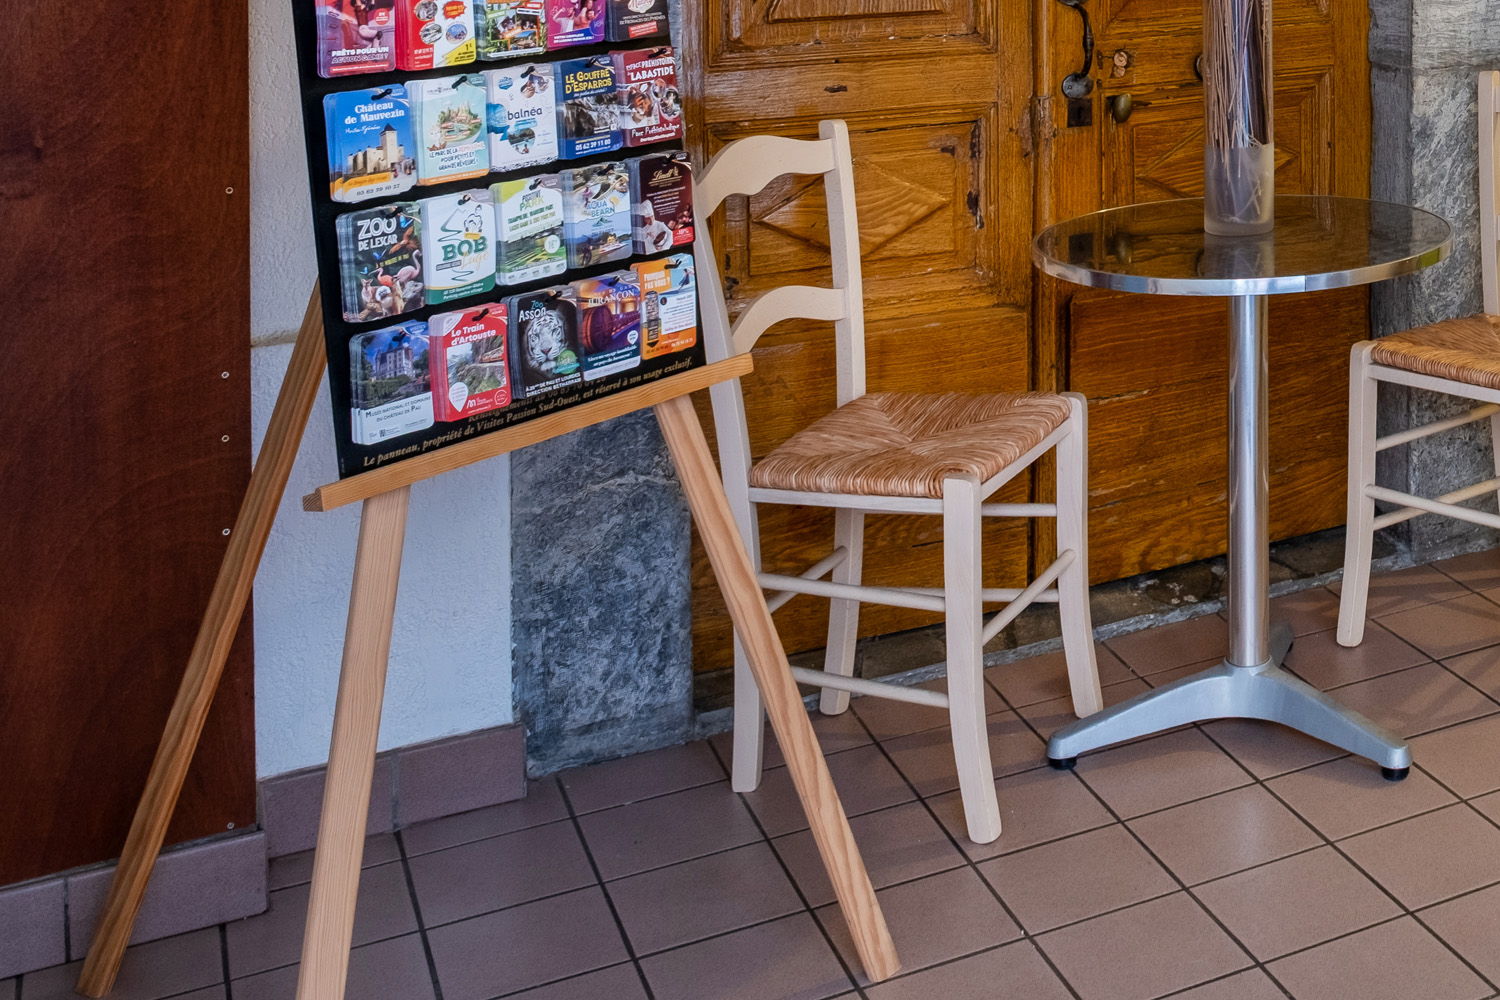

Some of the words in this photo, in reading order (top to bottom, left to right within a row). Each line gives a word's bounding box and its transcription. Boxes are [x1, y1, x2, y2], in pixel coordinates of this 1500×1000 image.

[565, 74, 575, 84] LE
[576, 68, 610, 82] GOUFFRE
[630, 66, 674, 81] LABASTIDE
[565, 78, 612, 94] D'ESPARROS
[354, 102, 394, 114] Château
[508, 106, 542, 120] balnéa
[344, 116, 358, 125] de
[360, 108, 405, 123] Mauvezin
[632, 129, 644, 138] Parc
[654, 168, 674, 180] Lindt
[520, 196, 544, 210] PARK
[358, 216, 397, 240] ZOO
[358, 240, 370, 252] DE
[370, 234, 398, 248] LESCAR
[442, 236, 488, 261] BOB
[531, 300, 544, 310] Zoo
[588, 290, 636, 308] JURANÇON
[451, 329, 496, 346] d'Artouste
[452, 330, 462, 338] Le
[463, 323, 484, 334] Train
[363, 456, 374, 467] Le
[376, 444, 421, 466] panneau,
[422, 432, 462, 451] propriété
[464, 424, 475, 436] de
[476, 418, 505, 432] Visites
[506, 408, 537, 422] Passion
[538, 394, 581, 412] Sud-Ouest,
[582, 390, 594, 399] est
[594, 382, 622, 395] réservé
[629, 376, 642, 384] son
[643, 368, 662, 381] usage
[664, 356, 692, 373] exclusif.
